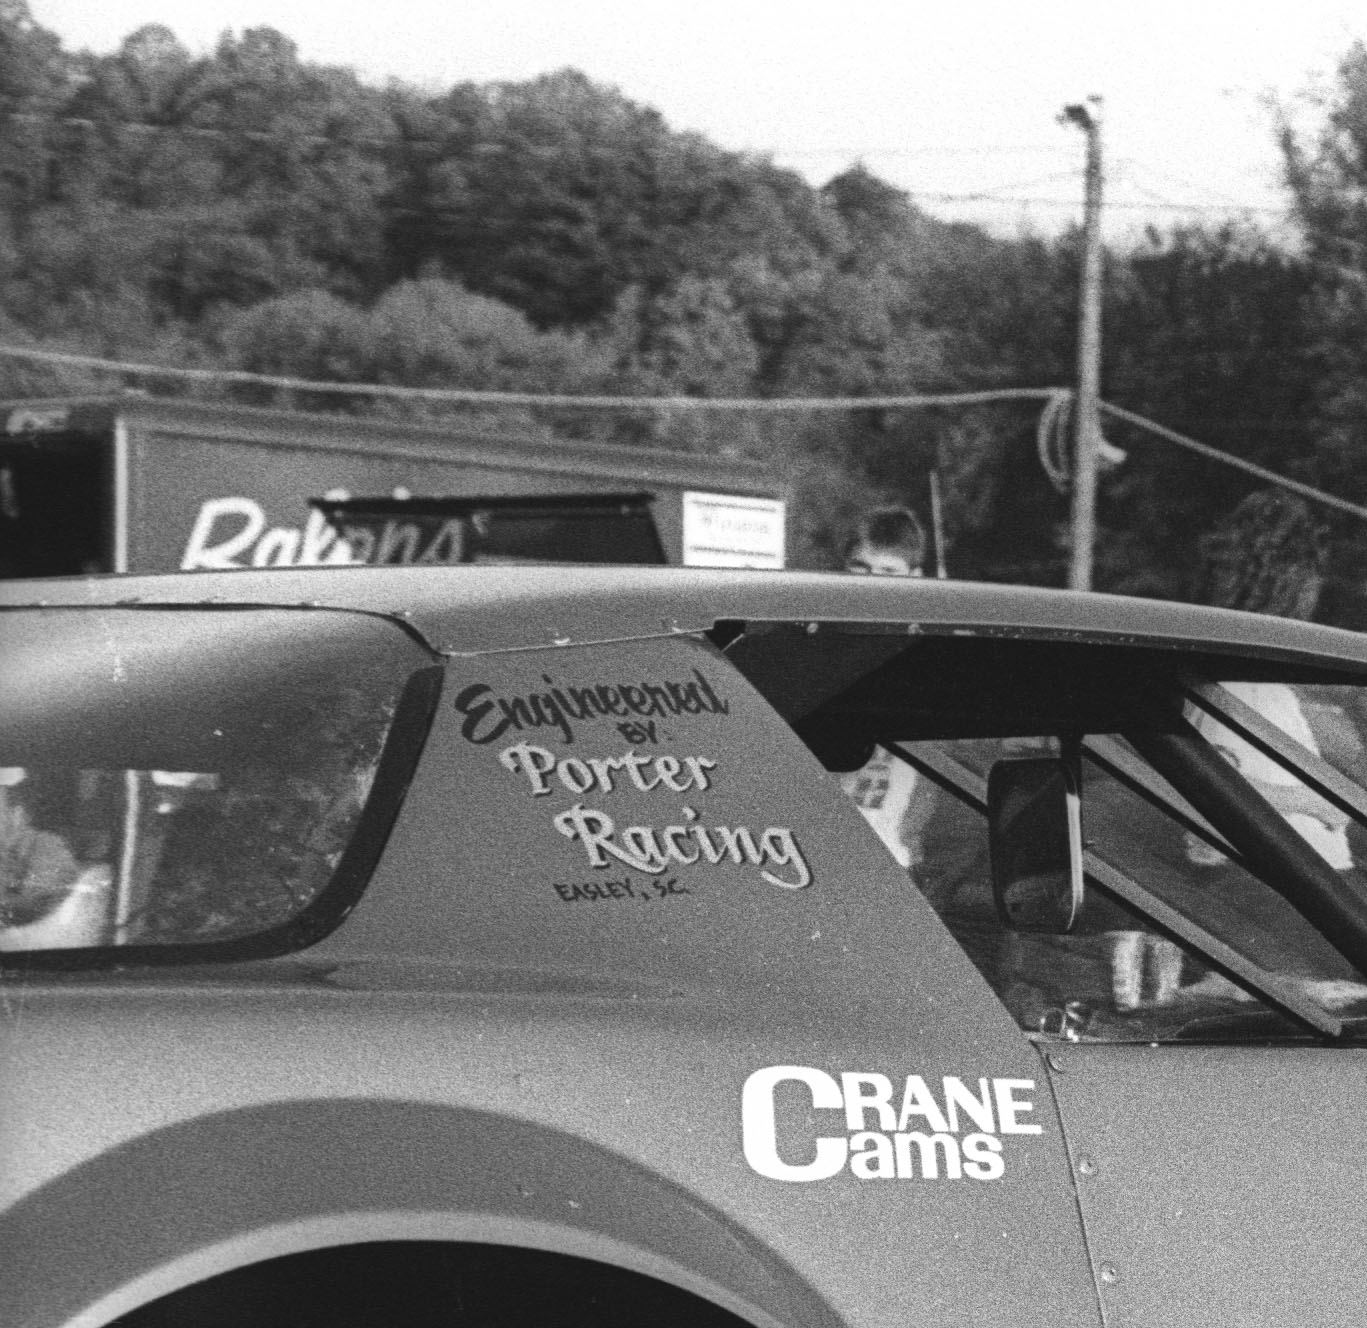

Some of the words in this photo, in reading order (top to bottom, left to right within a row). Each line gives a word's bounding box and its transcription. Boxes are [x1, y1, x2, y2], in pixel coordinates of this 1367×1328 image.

[454, 668, 730, 744] Engineered
[497, 742, 718, 797] Porter
[553, 803, 813, 890] Racing
[741, 1065, 1043, 1182] CRANE
